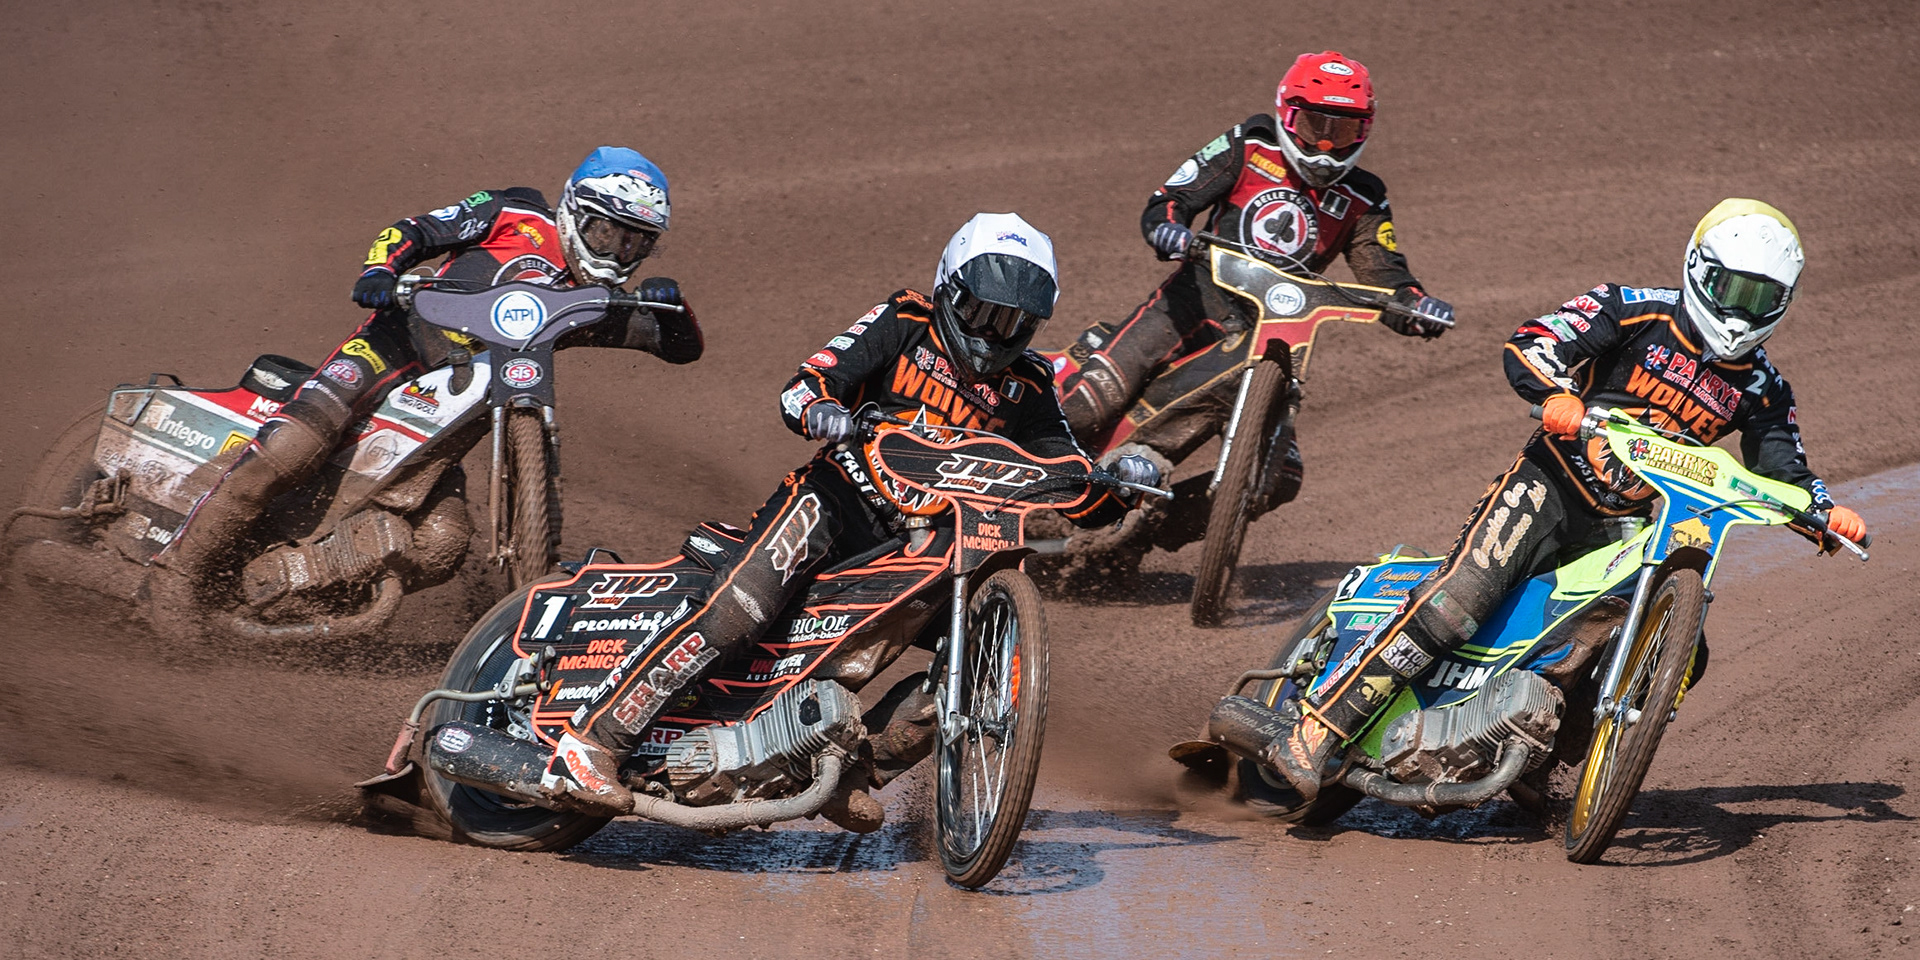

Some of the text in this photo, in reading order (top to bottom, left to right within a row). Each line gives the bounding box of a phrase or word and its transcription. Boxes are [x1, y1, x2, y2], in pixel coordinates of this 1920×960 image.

[1254, 192, 1286, 208] BELLE
[1272, 293, 1299, 307] ATPI
[502, 308, 534, 321] ATPI
[511, 366, 532, 380] STS
[1008, 381, 1018, 399] 1
[1745, 370, 1767, 396] 2
[1649, 443, 1718, 479] PARRYS
[938, 457, 1044, 485] JWP
[1646, 459, 1714, 487] INTERNATIONAL
[978, 523, 1002, 538] DICK
[1374, 568, 1422, 583] Complete
[590, 576, 675, 595] JWP
[531, 596, 568, 640] 1
[587, 639, 628, 654] DICK
[1384, 646, 1420, 677] SKIPS
[613, 632, 706, 726] SHARP
[1427, 661, 1495, 690] JHM
